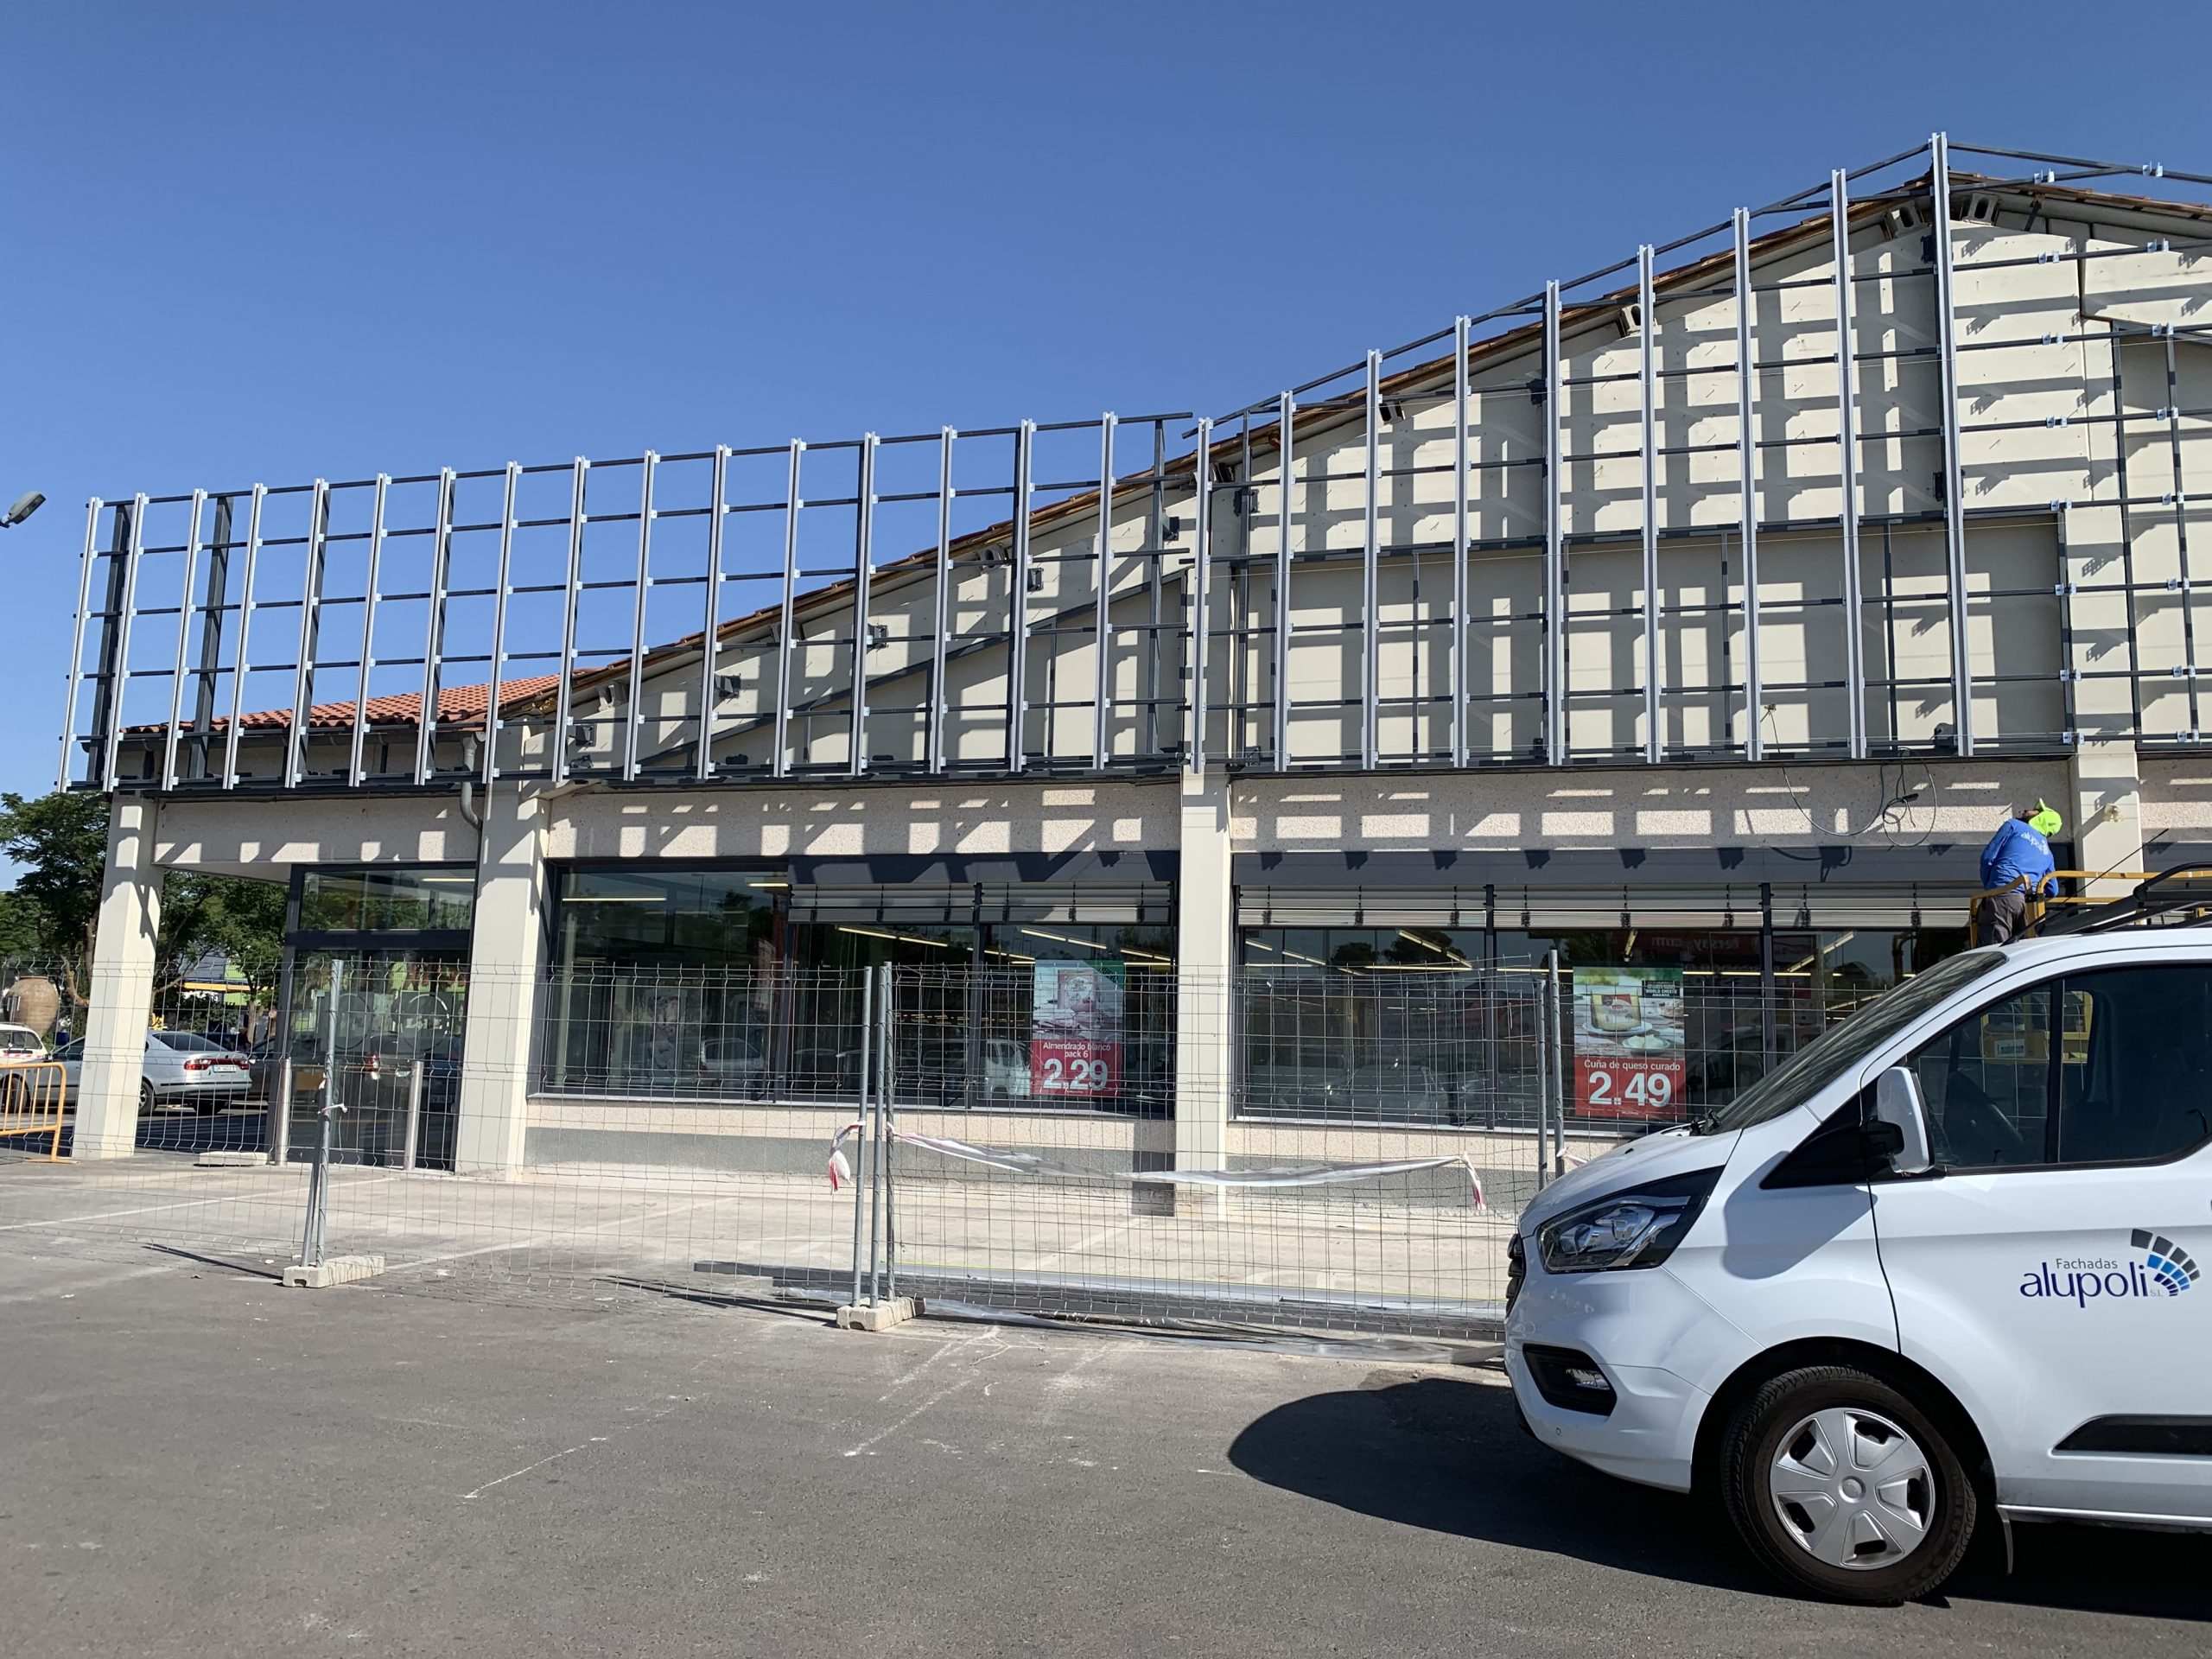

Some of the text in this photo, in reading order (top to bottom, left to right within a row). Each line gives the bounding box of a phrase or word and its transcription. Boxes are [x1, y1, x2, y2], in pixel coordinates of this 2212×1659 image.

[1043, 1042, 1085, 1051] Almendrado
[1043, 1058, 1108, 1090] 2.29
[1584, 1059, 1681, 1071] Cuña de queso curado
[1589, 1071, 1671, 1108] 2.49
[2056, 1258, 2119, 1269] Fachadas
[2019, 1261, 2148, 1308] alupoli
